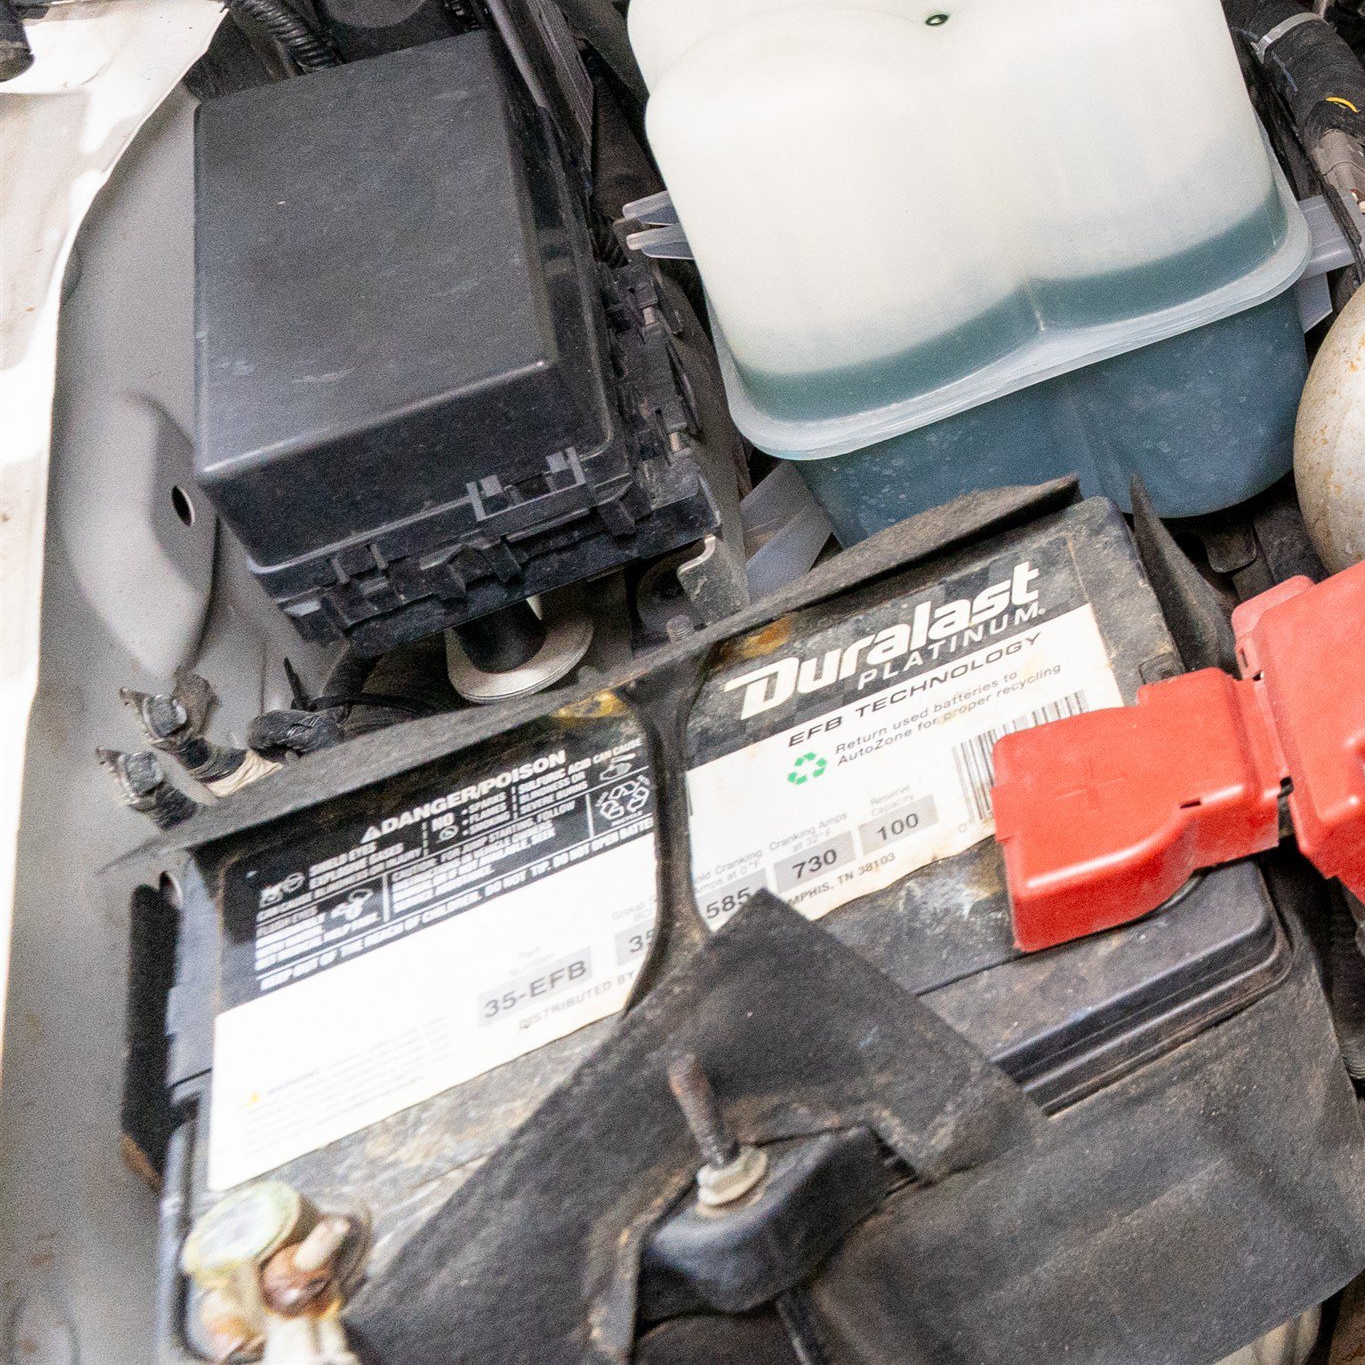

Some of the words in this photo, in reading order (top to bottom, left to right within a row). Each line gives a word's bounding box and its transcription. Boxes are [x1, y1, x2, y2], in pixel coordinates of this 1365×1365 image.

[721, 560, 1040, 721] Duralast
[787, 715, 843, 748] EFB
[856, 631, 1042, 718] TECHNOLOGY
[835, 725, 889, 755] Return
[892, 707, 930, 734] used
[933, 678, 1000, 713] batteries
[1002, 670, 1018, 682] to
[837, 730, 914, 766] AutoZone
[917, 715, 938, 733] for
[941, 698, 991, 730] proper
[995, 663, 1062, 700] recycling
[380, 749, 566, 836] DANGER/POISON
[869, 784, 911, 806] Reserve
[870, 793, 915, 817] Capacity
[431, 811, 455, 833] NO
[768, 823, 817, 851] Cranking
[818, 811, 848, 829] Amps
[876, 811, 920, 842] 100
[715, 848, 764, 878] Cranking
[791, 841, 805, 853] at
[791, 848, 838, 881] 730
[838, 871, 854, 885] TN
[857, 851, 896, 879] 38103
[611, 901, 645, 922] Group
[705, 886, 751, 920] 585
[483, 959, 587, 1019] 35-EFB
[517, 980, 612, 1030] DISTRIBUTED
